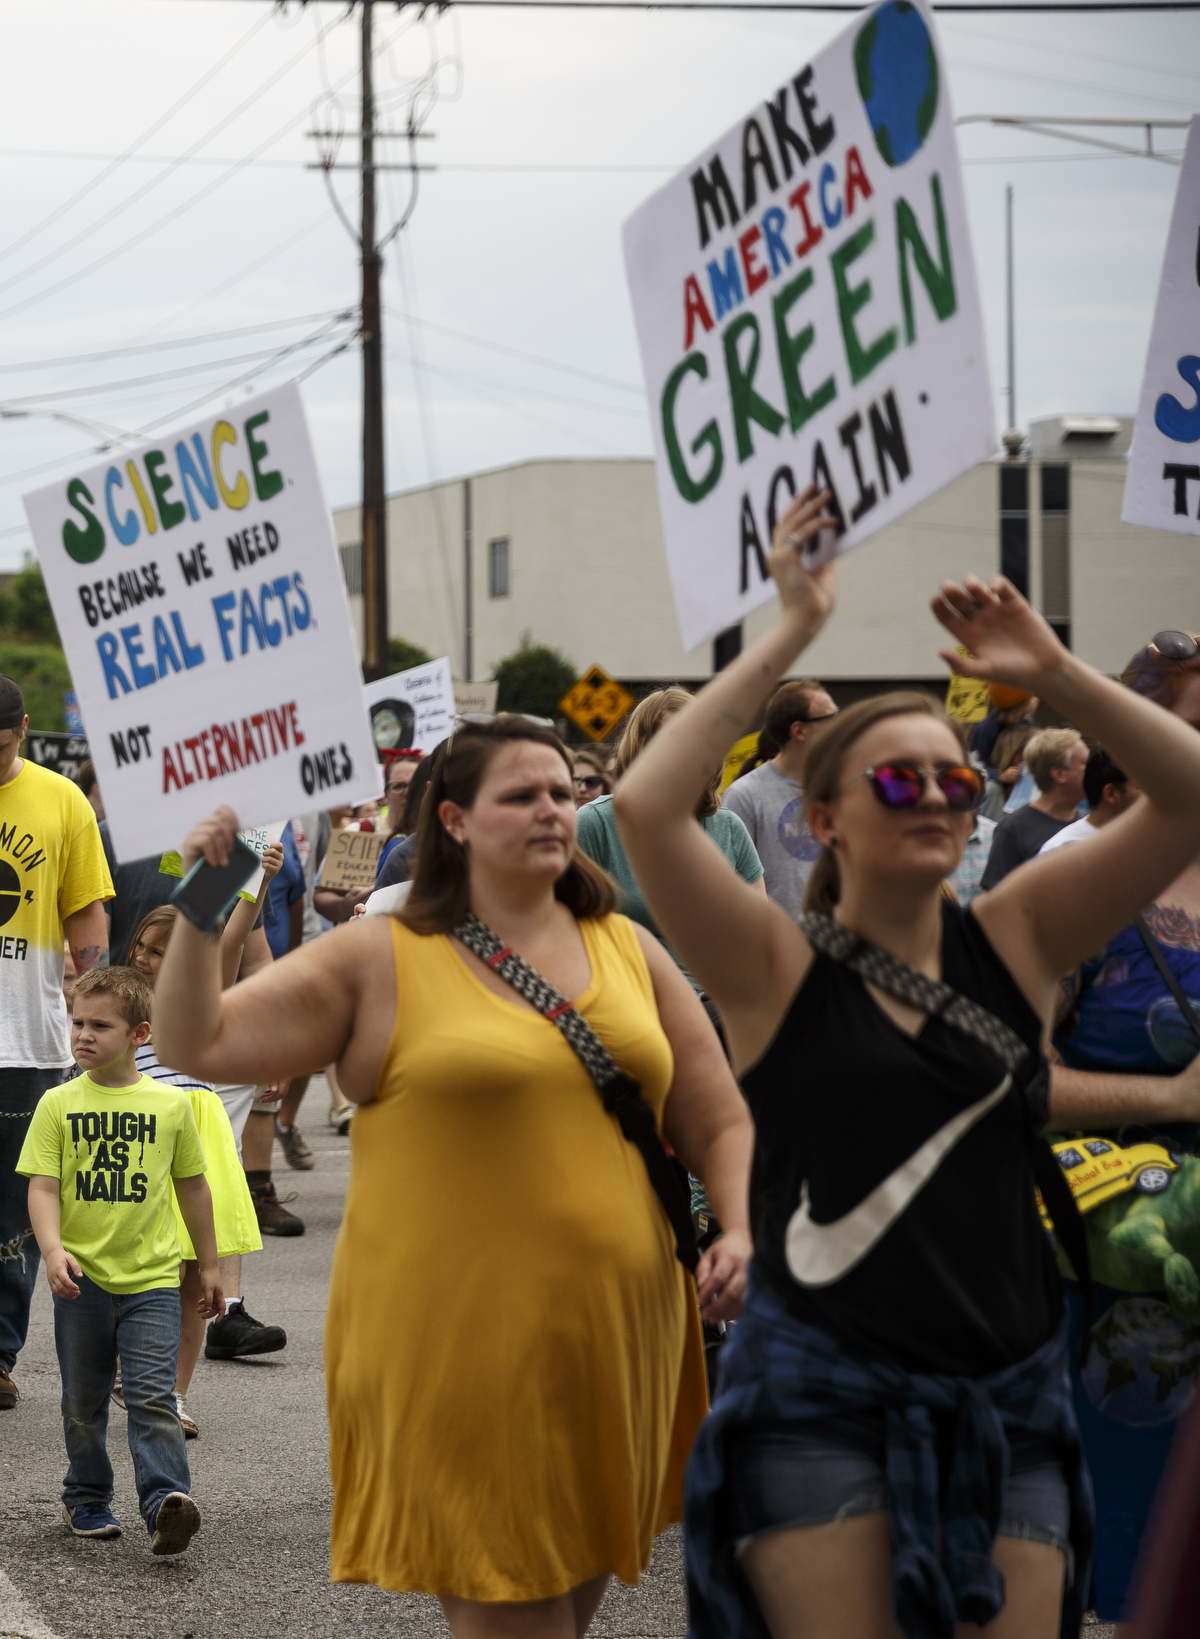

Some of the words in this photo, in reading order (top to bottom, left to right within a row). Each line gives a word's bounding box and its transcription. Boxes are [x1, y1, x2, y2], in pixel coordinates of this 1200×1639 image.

[690, 64, 836, 251] MAKE
[684, 146, 874, 351] AMERICA
[662, 172, 958, 504] GREEN
[78, 562, 165, 627] BECAUSE
[177, 542, 213, 586] WE
[227, 521, 279, 570] NEED
[97, 611, 205, 700] REAL
[110, 724, 152, 768] NOT
[162, 701, 306, 794] ALTERNATIVE
[250, 828, 268, 842] THE
[66, 1111, 157, 1145] TOUGH
[92, 1141, 130, 1172] AS
[75, 1170, 148, 1204] NAILS
